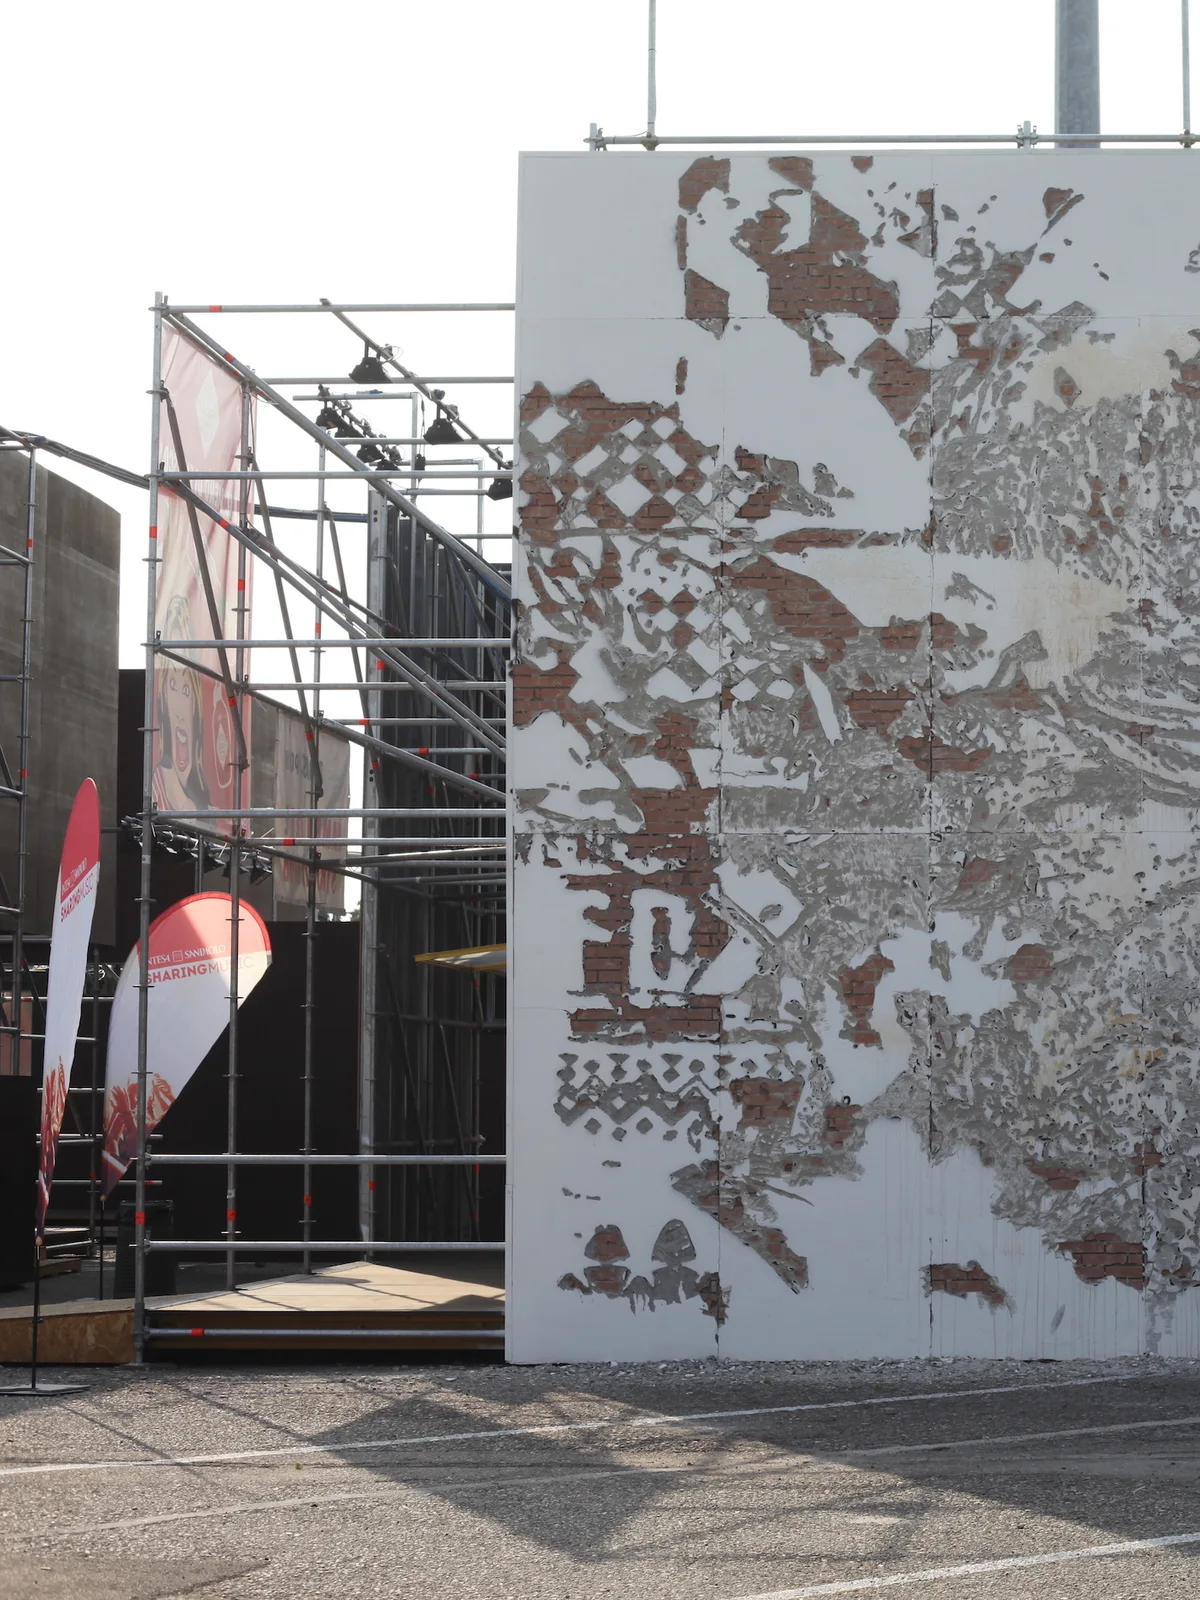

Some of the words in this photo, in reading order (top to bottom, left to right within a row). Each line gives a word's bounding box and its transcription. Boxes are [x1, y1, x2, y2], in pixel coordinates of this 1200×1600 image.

[148, 954, 170, 965] NTESA
[184, 944, 226, 959] SANPAOLO
[147, 956, 255, 985] SHARINGMUIC
